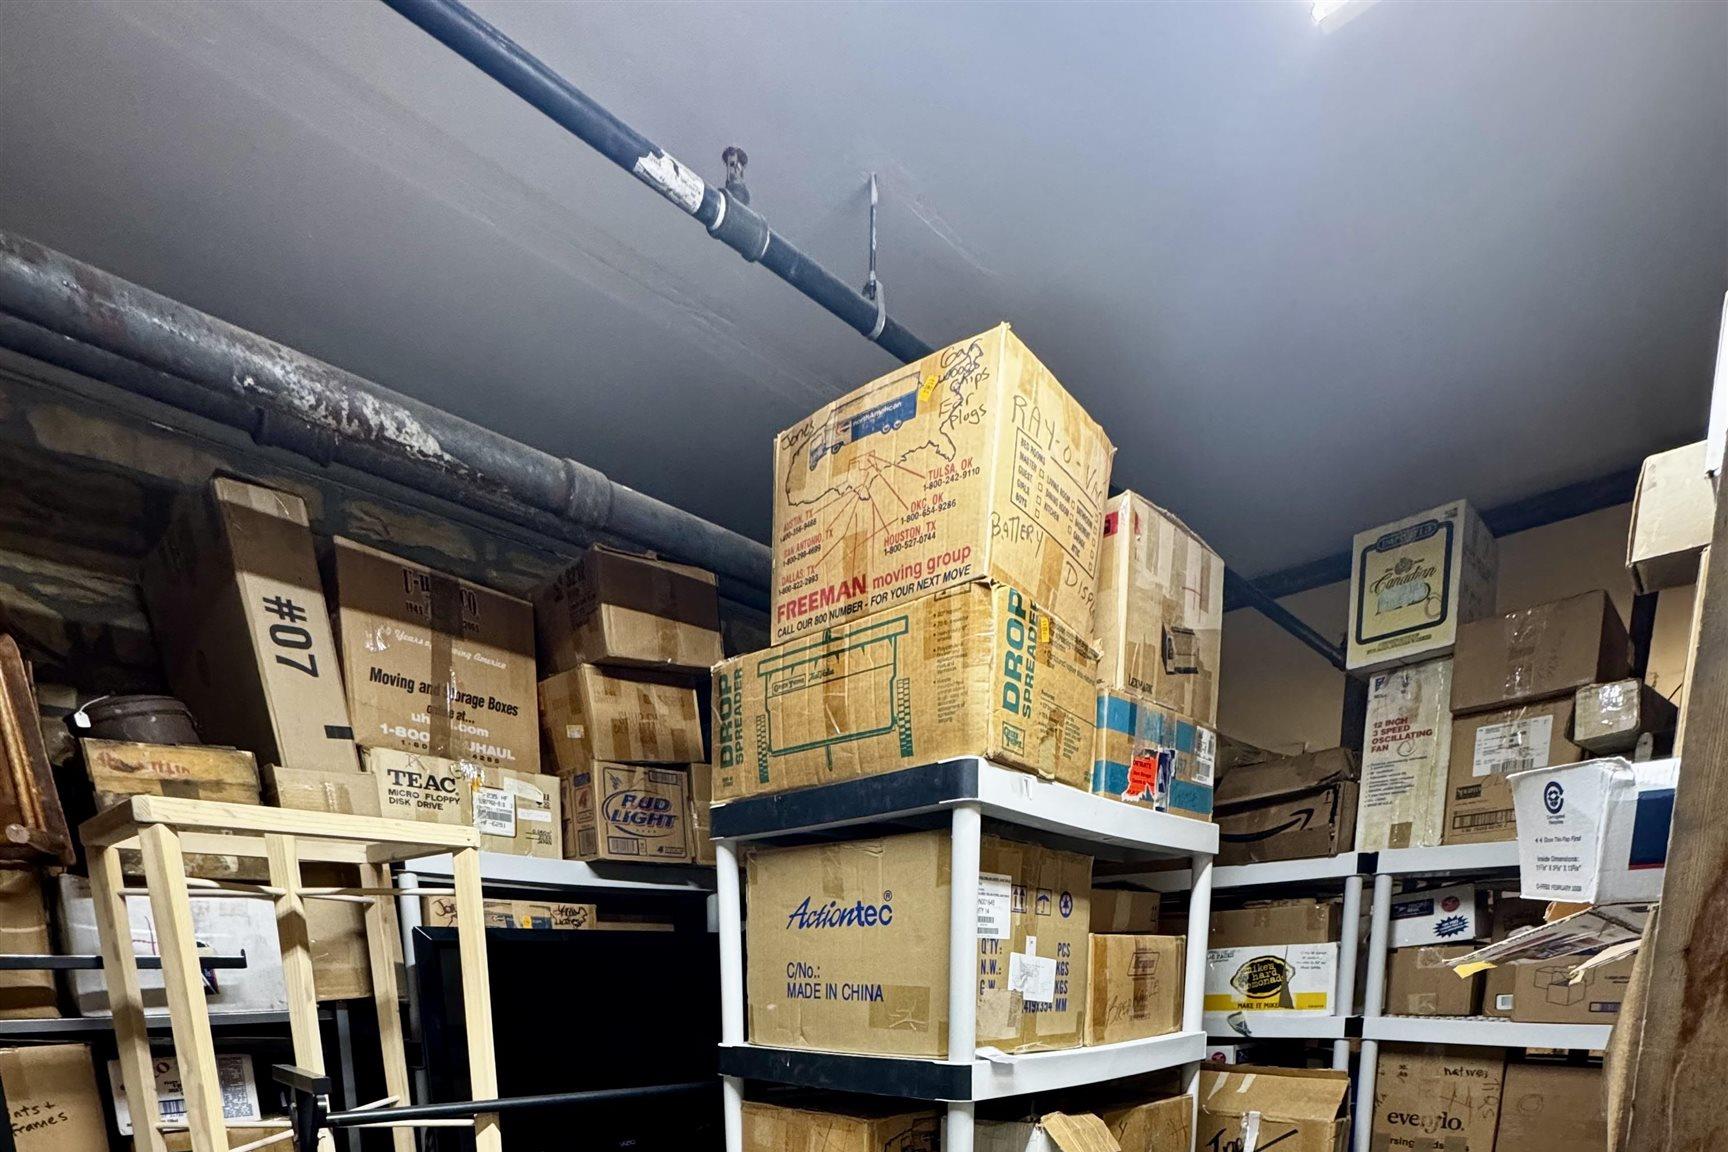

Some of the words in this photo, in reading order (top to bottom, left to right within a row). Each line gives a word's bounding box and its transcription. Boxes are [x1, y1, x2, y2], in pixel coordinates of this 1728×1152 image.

[950, 404, 987, 430] plugs
[781, 419, 815, 450] Jones
[961, 457, 974, 469] OK
[923, 466, 980, 491] 1-800-242-9110
[932, 492, 944, 504] OK
[901, 499, 956, 525] 1-800-654-9286
[926, 521, 936, 532] TX
[991, 511, 1044, 559] BATTERY
[884, 532, 936, 556] 1-800-527-0744
[777, 574, 867, 624] FREEMAN
[872, 559, 922, 590] moving
[927, 546, 971, 574] group
[1370, 565, 1437, 594] Canadian
[777, 620, 794, 637] CALL
[797, 616, 813, 632] OUR
[814, 614, 827, 626] 800
[829, 602, 863, 622] NUMBER
[870, 591, 888, 607] FOR
[891, 583, 915, 600] YOUR
[917, 574, 940, 592] NEXT
[943, 564, 971, 581] MOVE
[262, 596, 319, 677] #07
[395, 629, 424, 645] Years
[474, 652, 507, 670] America
[1002, 586, 1028, 715] DROP
[370, 667, 415, 694] Moving
[488, 697, 519, 717] Boxes
[720, 674, 734, 769] DROP
[735, 667, 745, 764] SPREADER
[1385, 717, 1408, 727] INCH
[1372, 729, 1433, 745] OSCILLATING
[1381, 726, 1411, 736] SPEED
[1371, 744, 1389, 753] FAN
[387, 768, 457, 793] TEAC
[388, 788, 420, 799] MICRO
[425, 793, 461, 806] FLOPPY
[388, 797, 412, 807] DISK
[417, 800, 444, 811] DRIVE
[611, 809, 677, 829] LIGHT
[786, 896, 892, 930] Actiontec
[981, 938, 1002, 955] Q'TY:
[1057, 942, 1071, 957] PCS
[786, 962, 821, 979] C/No.:
[981, 959, 1001, 975] N.W.:
[1252, 970, 1277, 981] hard
[787, 982, 821, 999] MADE
[825, 983, 837, 999] IN
[842, 984, 884, 1002] CHINA
[1055, 1000, 1067, 1012] MM
